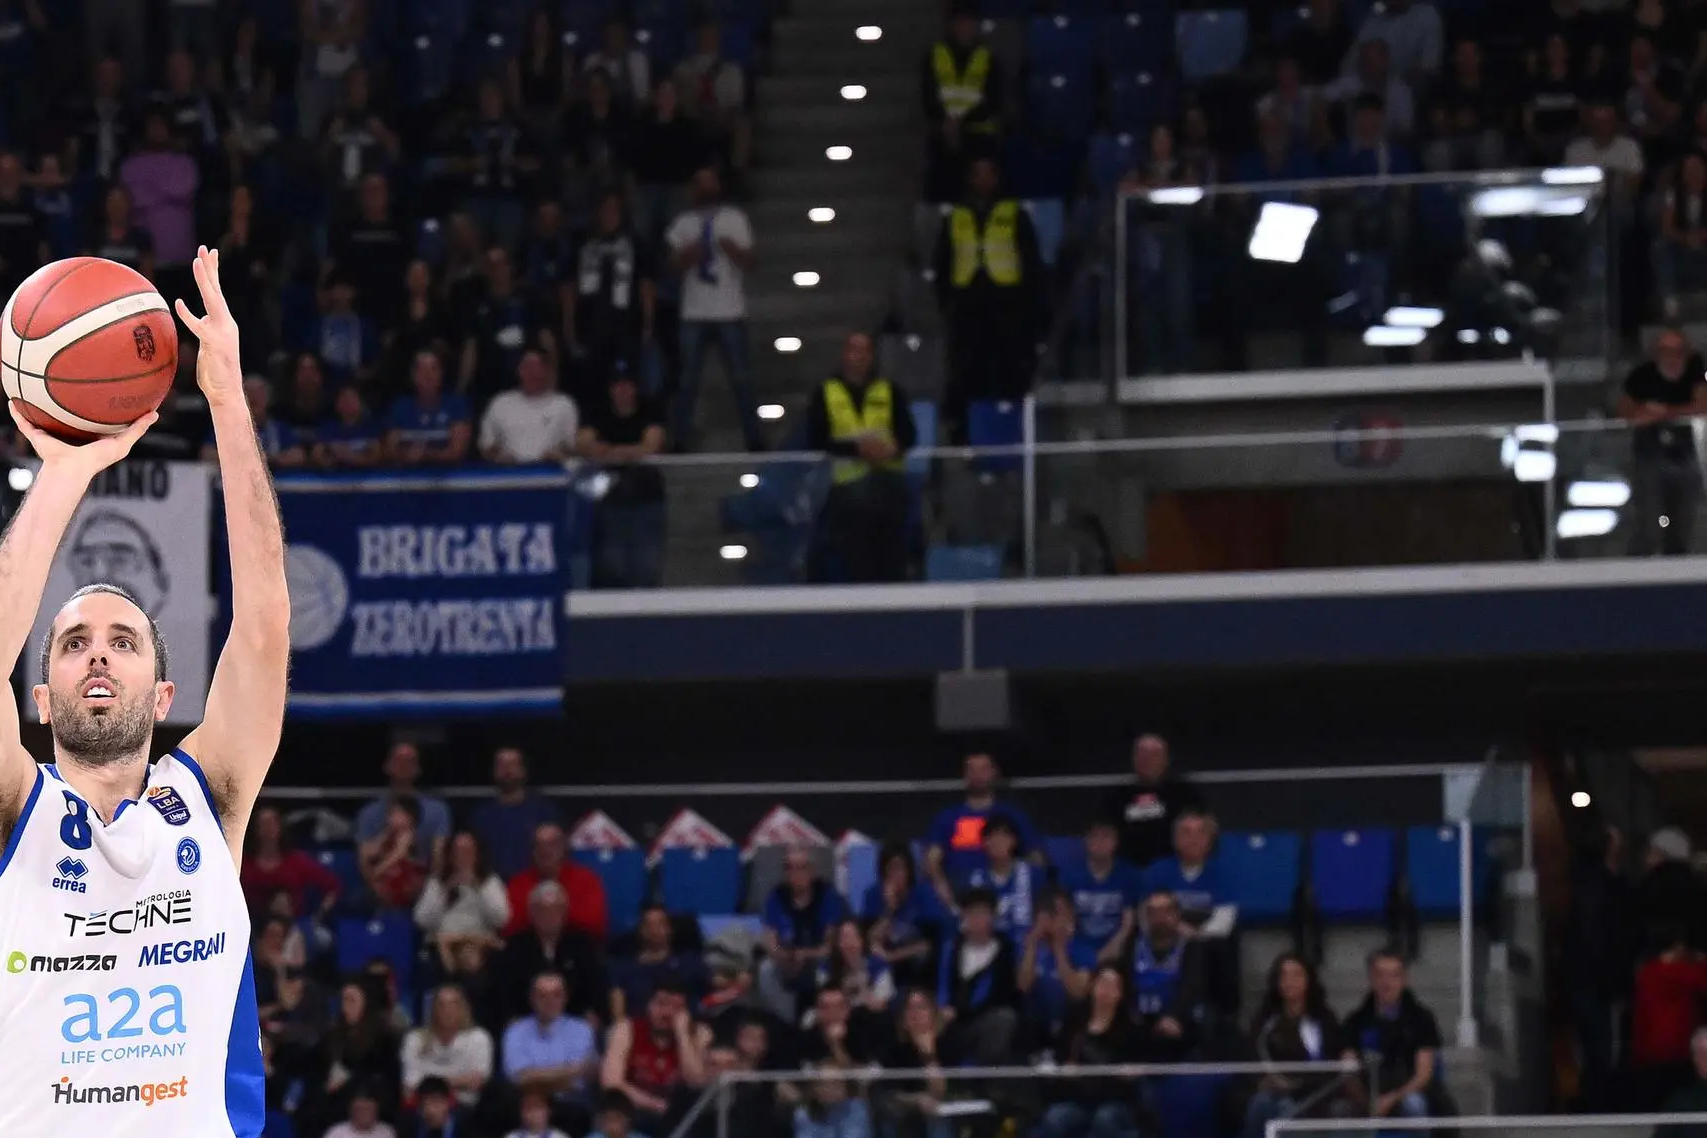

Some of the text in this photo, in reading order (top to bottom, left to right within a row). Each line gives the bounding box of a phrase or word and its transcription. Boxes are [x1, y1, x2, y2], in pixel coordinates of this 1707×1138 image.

[357, 523, 556, 577] BRIGATA
[351, 598, 557, 656] ZEROTRENTA
[156, 796, 180, 809] LBA
[60, 790, 92, 850] 8
[52, 877, 86, 893] errea
[30, 954, 117, 973] mazza
[61, 984, 187, 1043] a2a
[61, 1042, 186, 1064] LIFE COMPANY
[51, 1076, 188, 1106] Humangest
